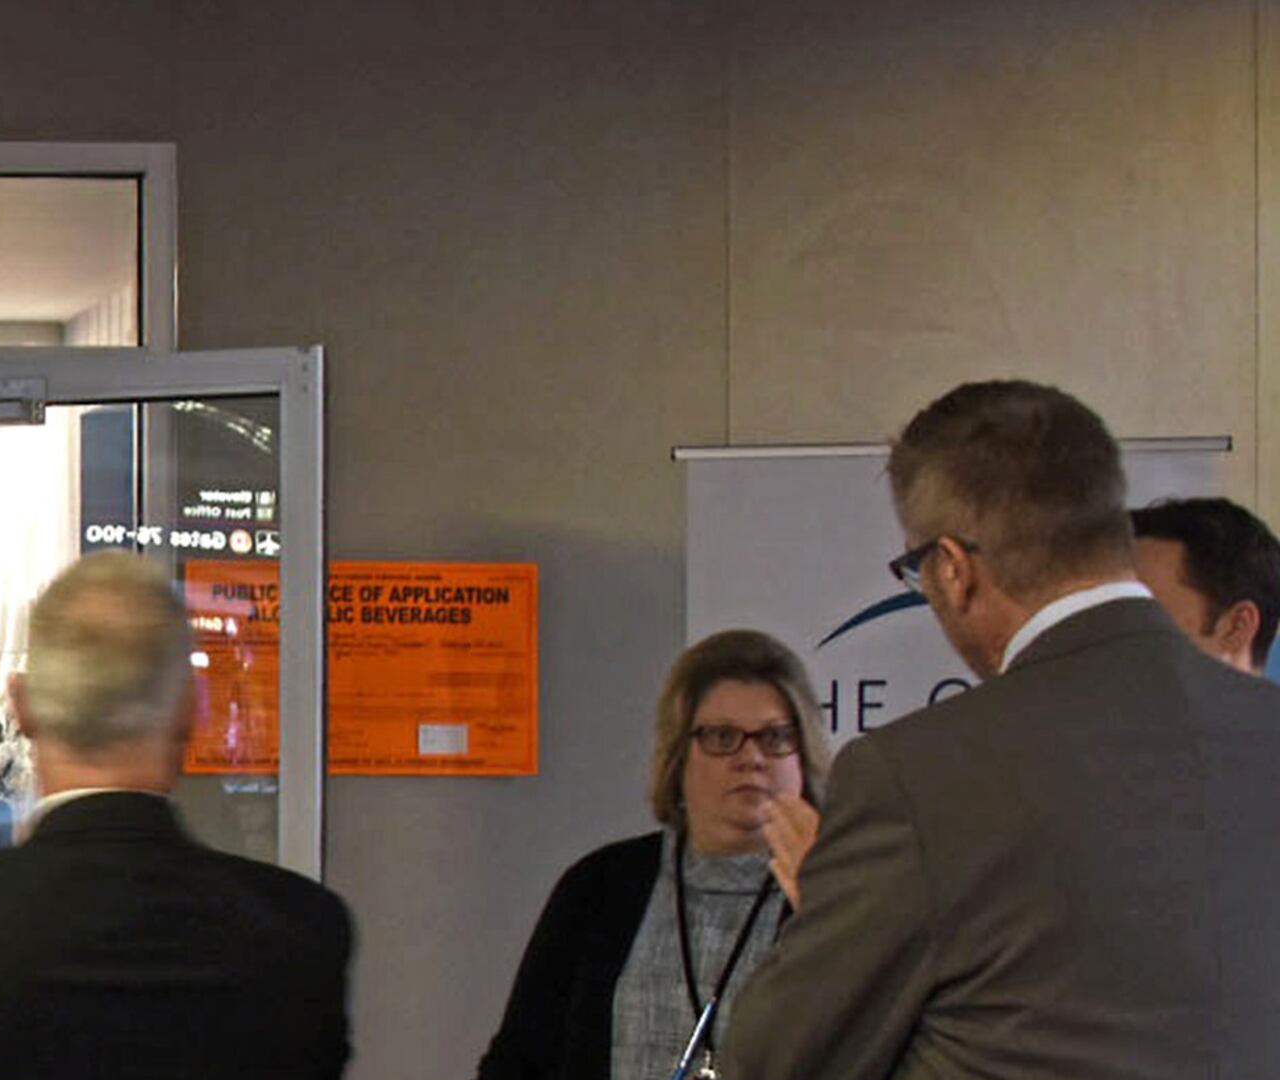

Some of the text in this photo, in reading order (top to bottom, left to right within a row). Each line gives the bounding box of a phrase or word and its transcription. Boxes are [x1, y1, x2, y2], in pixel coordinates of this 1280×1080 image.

[212, 583, 278, 602] PUBLIC
[360, 586, 382, 603] OF
[389, 585, 510, 605] APPLICATION
[360, 606, 472, 625] BEVERAGES
